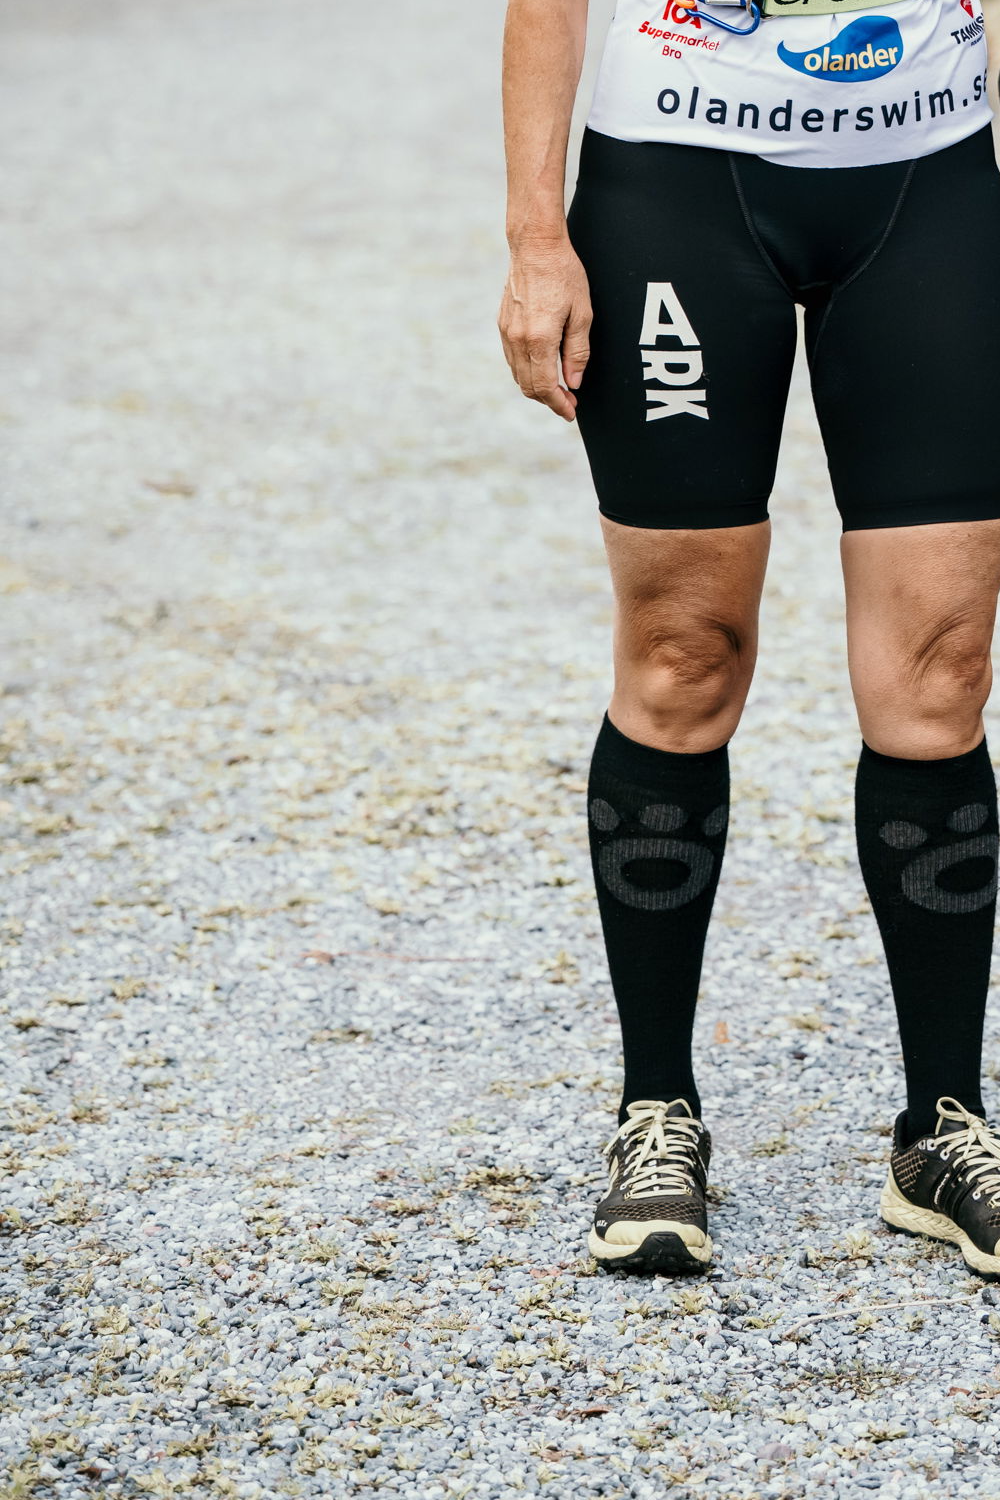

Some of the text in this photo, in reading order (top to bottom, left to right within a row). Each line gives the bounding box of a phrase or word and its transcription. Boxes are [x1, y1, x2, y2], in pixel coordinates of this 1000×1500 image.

[638, 20, 721, 52] Supermarket
[661, 44, 682, 59] Bro
[803, 43, 899, 72] olander
[638, 281, 710, 422] ARK
